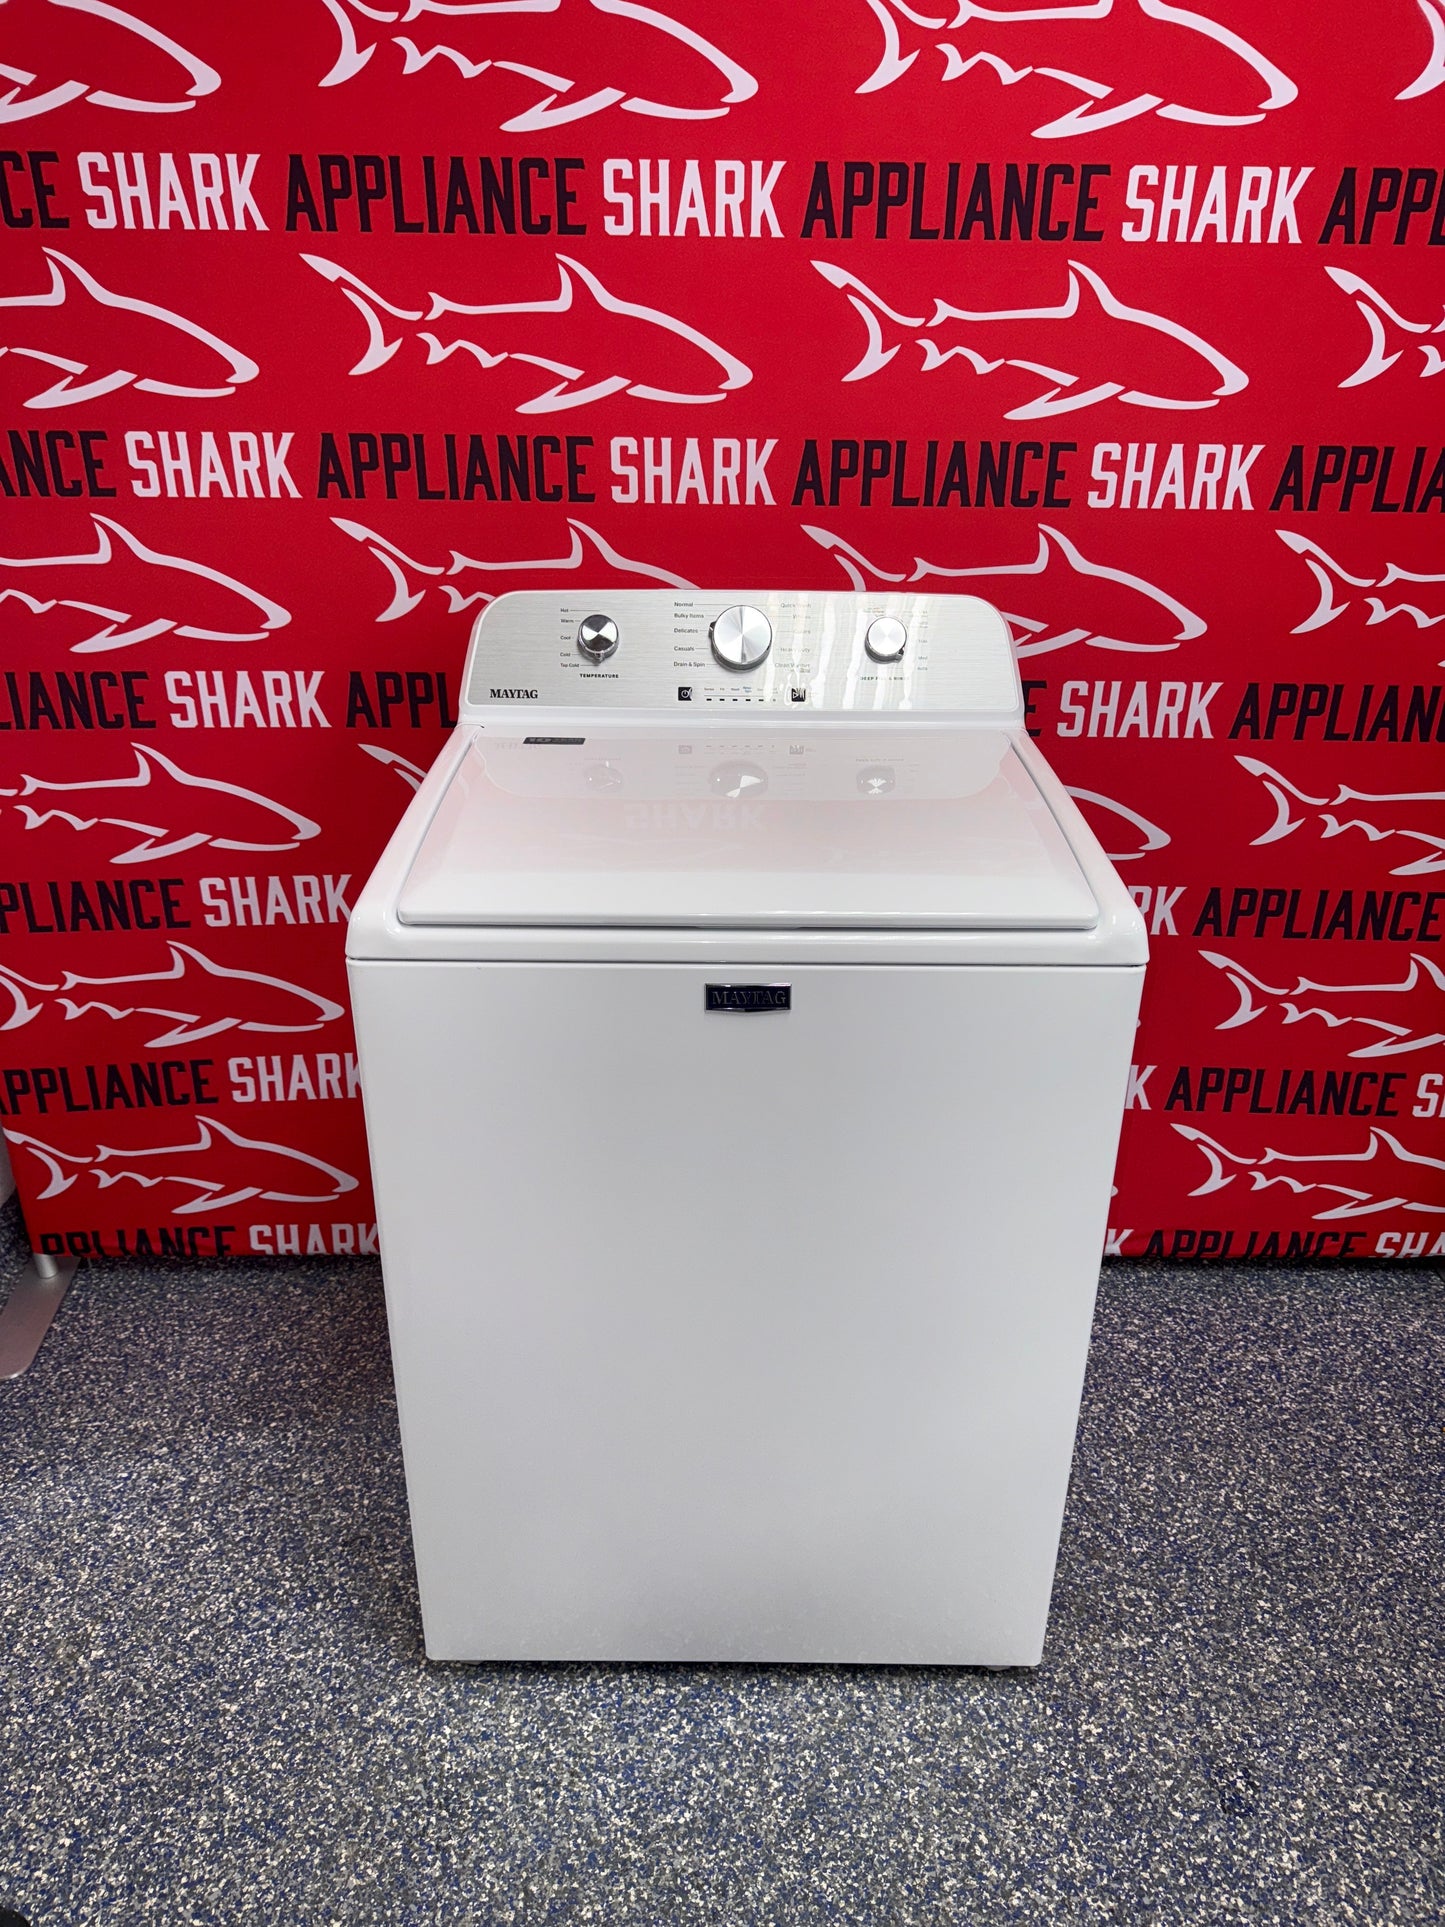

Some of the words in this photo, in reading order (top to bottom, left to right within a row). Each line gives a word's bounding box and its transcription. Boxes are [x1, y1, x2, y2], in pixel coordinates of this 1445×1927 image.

[77, 152, 269, 230] SHARK
[285, 154, 587, 234] APPLIANCE
[603, 159, 785, 237] SHARK
[800, 162, 1112, 241] APPLIANCE
[1121, 165, 1315, 243] SHARK
[125, 431, 302, 498] SHARK
[318, 432, 595, 501] APPLIANCE
[610, 436, 778, 503] SHARK
[791, 439, 1077, 507] APPLIANCE
[1087, 442, 1263, 509] SHARK
[164, 671, 332, 729] SHARK
[489, 688, 539, 700] MAYTAG
[1056, 680, 1224, 739] SHARK
[199, 874, 353, 927] SHARK
[1191, 886, 1445, 942] APPLIANCE
[712, 990, 787, 1005] MAYTAG
[227, 1052, 363, 1103] SHARK
[1163, 1066, 1407, 1117] APPLIANCE
